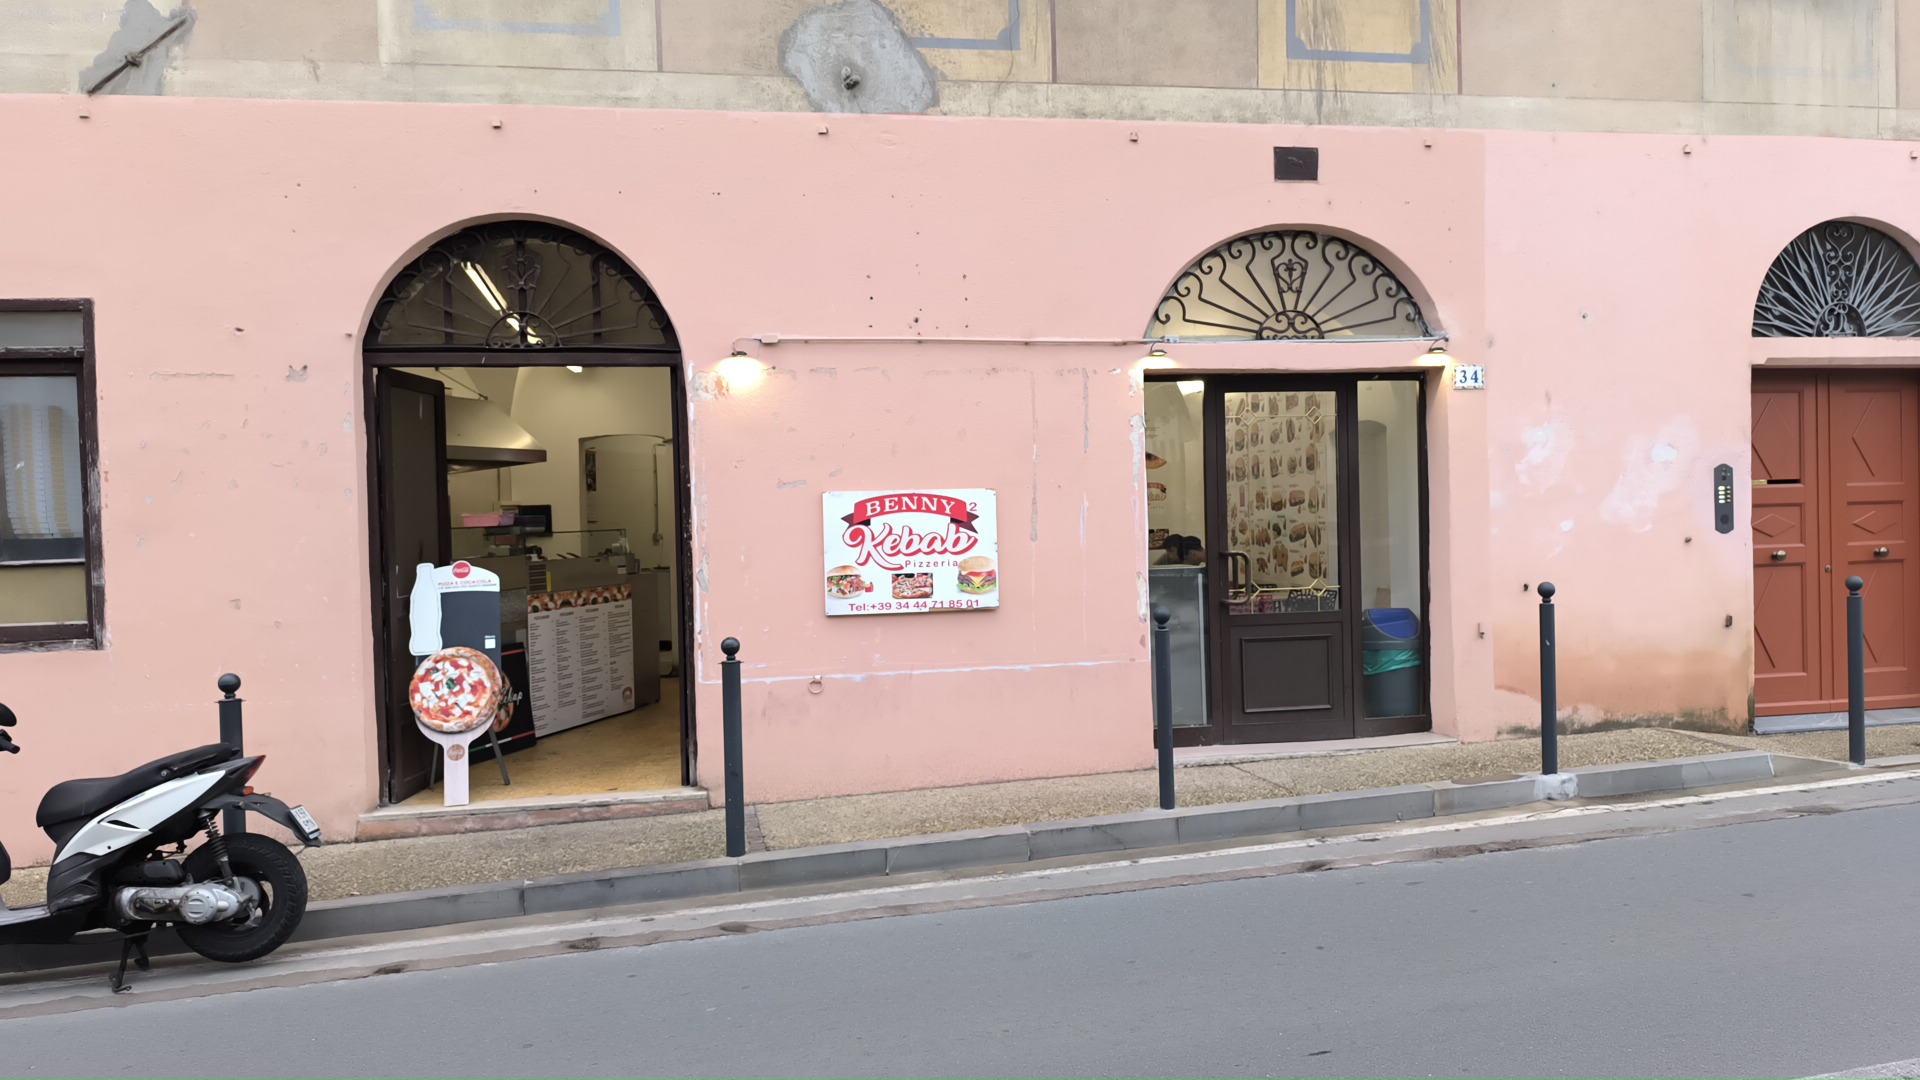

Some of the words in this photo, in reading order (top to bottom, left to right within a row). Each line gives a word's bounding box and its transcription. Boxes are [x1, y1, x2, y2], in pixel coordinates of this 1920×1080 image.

[1459, 369, 1479, 384] 34
[865, 496, 956, 516] BENNY
[969, 502, 977, 512] 2
[842, 523, 979, 571] Kebab
[905, 559, 958, 568] Pizzeria
[848, 601, 892, 612] Tel:+39
[895, 601, 910, 610] 34
[913, 600, 928, 609] 44
[932, 600, 944, 608] 71
[948, 599, 963, 608] 85
[966, 599, 980, 608] 01
